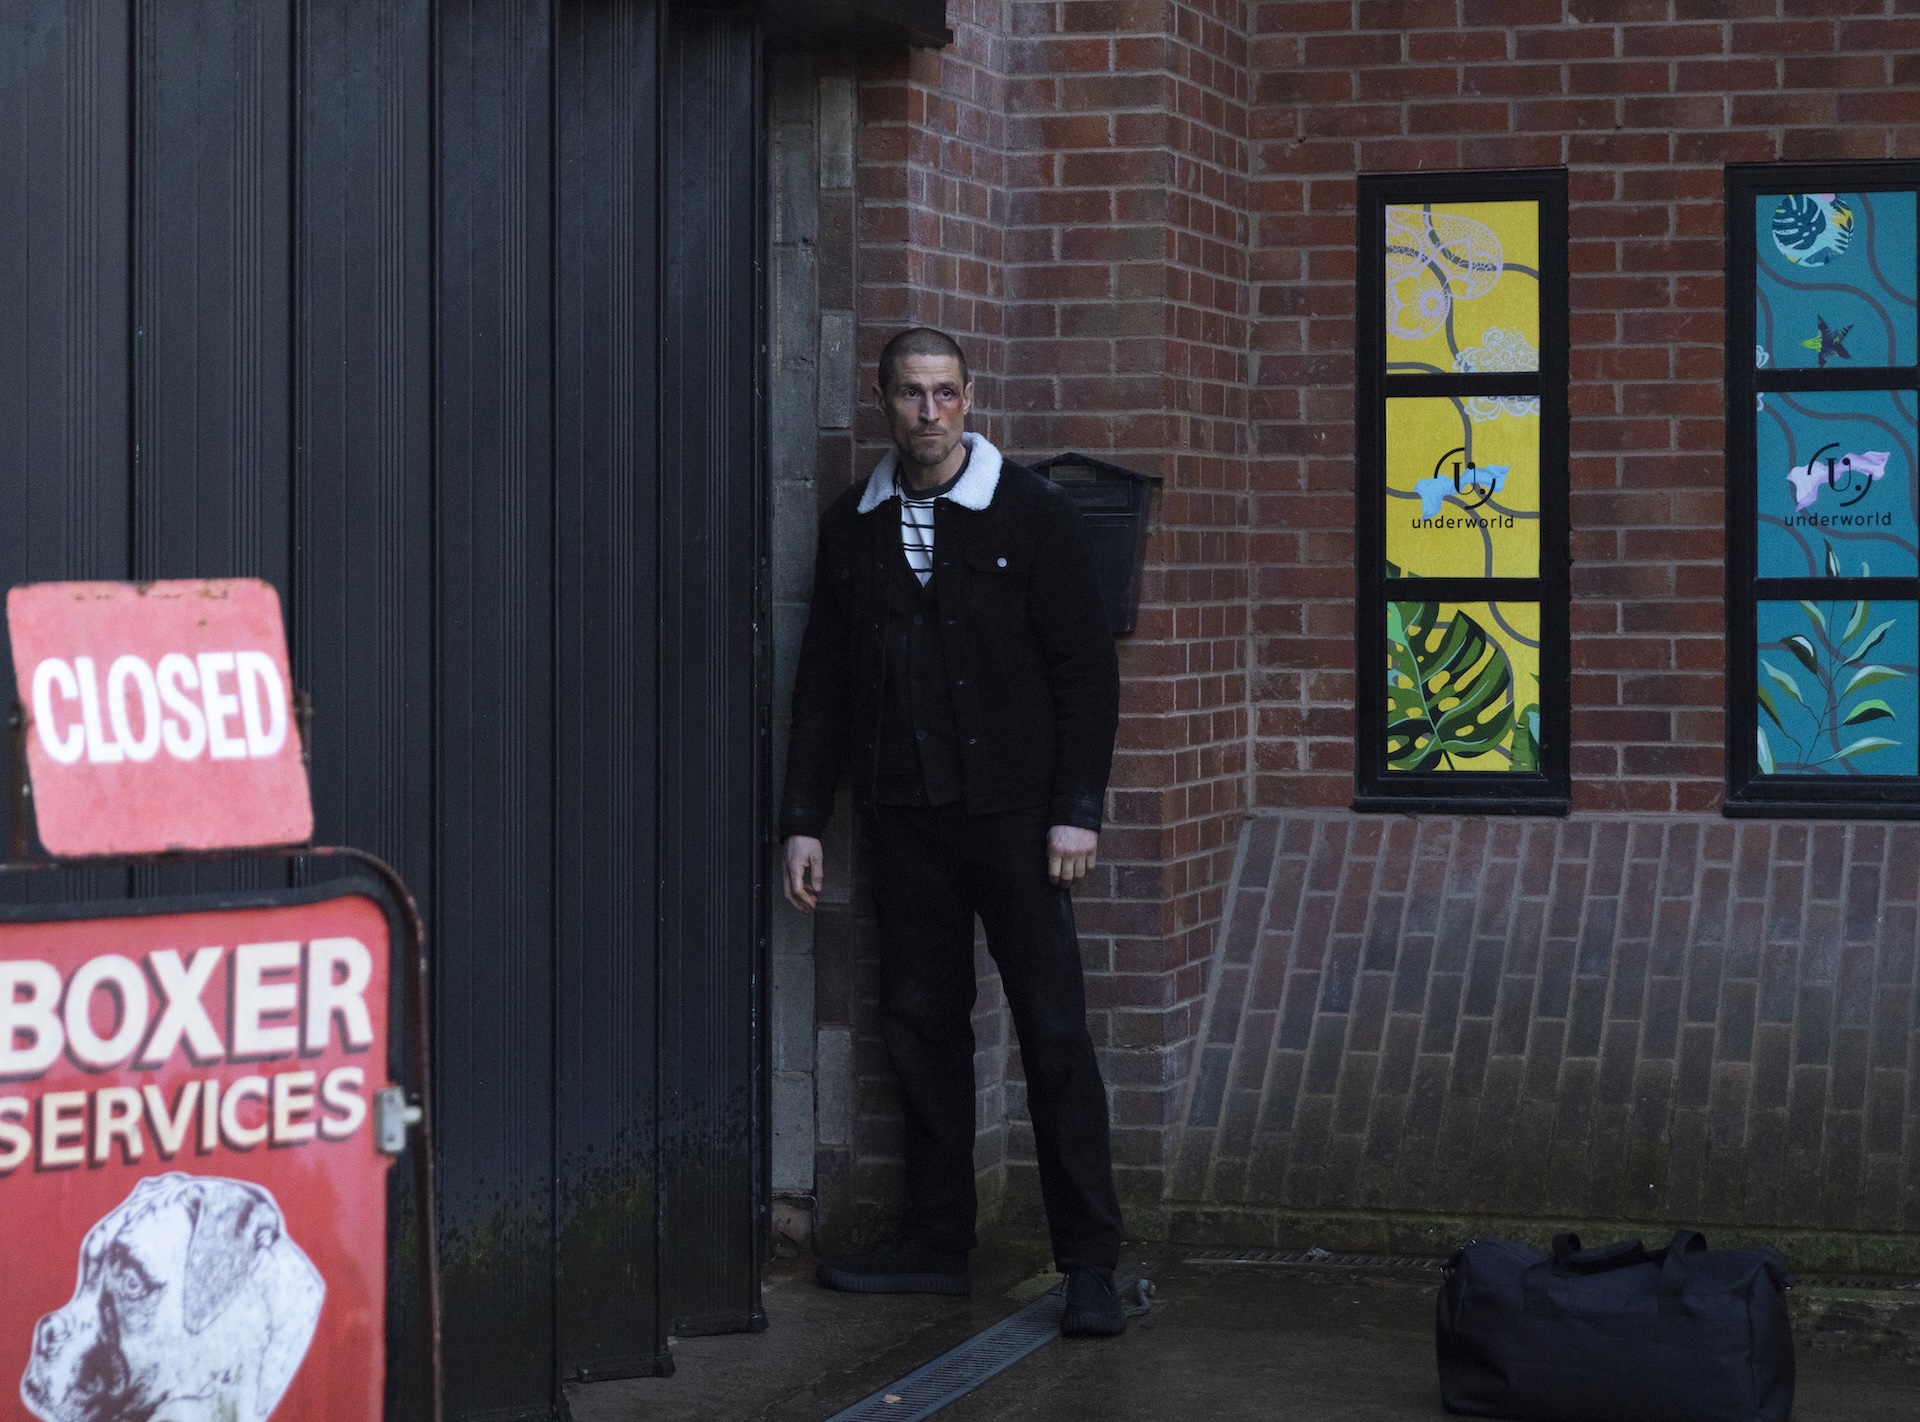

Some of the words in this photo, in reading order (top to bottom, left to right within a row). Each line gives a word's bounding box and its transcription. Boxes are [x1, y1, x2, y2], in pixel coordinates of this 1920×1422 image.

[1412, 515, 1514, 529] underworld
[1784, 512, 1892, 527] underworld
[32, 651, 288, 764] CLOSED
[0, 937, 373, 1073] BOXER
[0, 1067, 366, 1172] SERVICES
